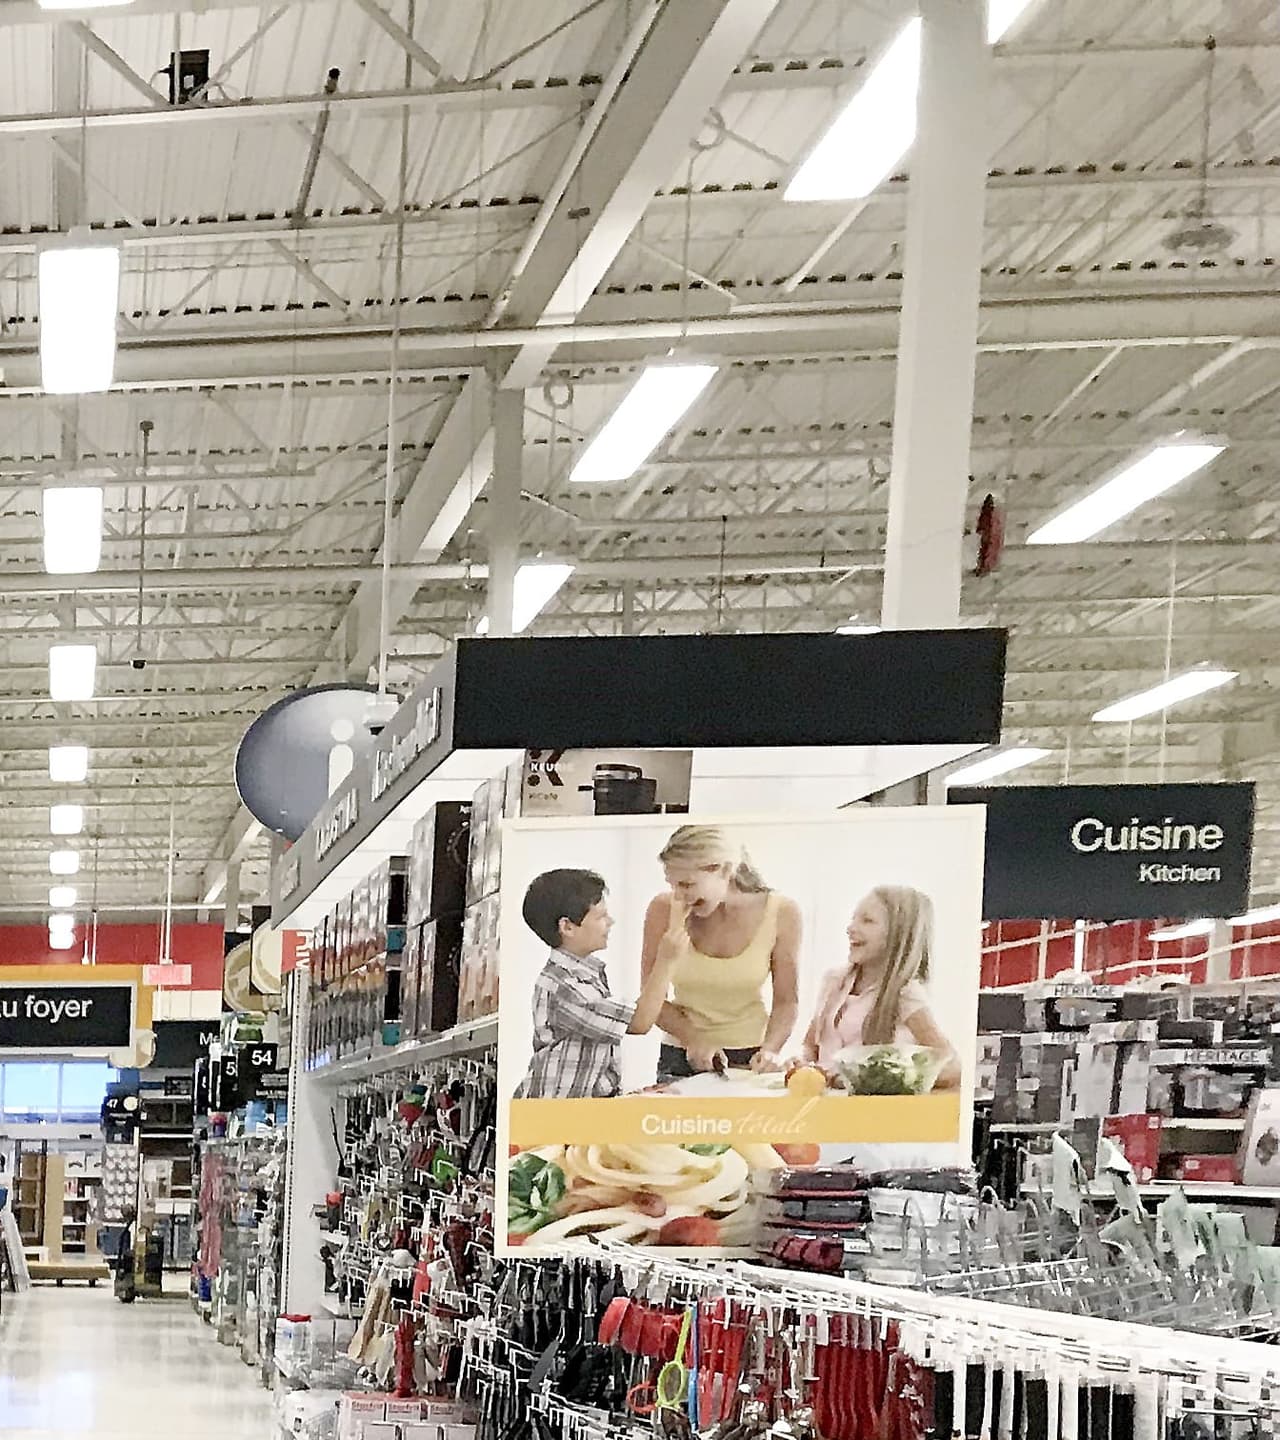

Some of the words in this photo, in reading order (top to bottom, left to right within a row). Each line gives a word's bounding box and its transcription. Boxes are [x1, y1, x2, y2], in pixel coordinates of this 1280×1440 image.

[1071, 817, 1224, 852] Cuisine
[1139, 863, 1221, 883] Kitchen
[25, 995, 93, 1023] foyer
[251, 1050, 273, 1066] 54
[641, 1114, 733, 1136] Cuisine
